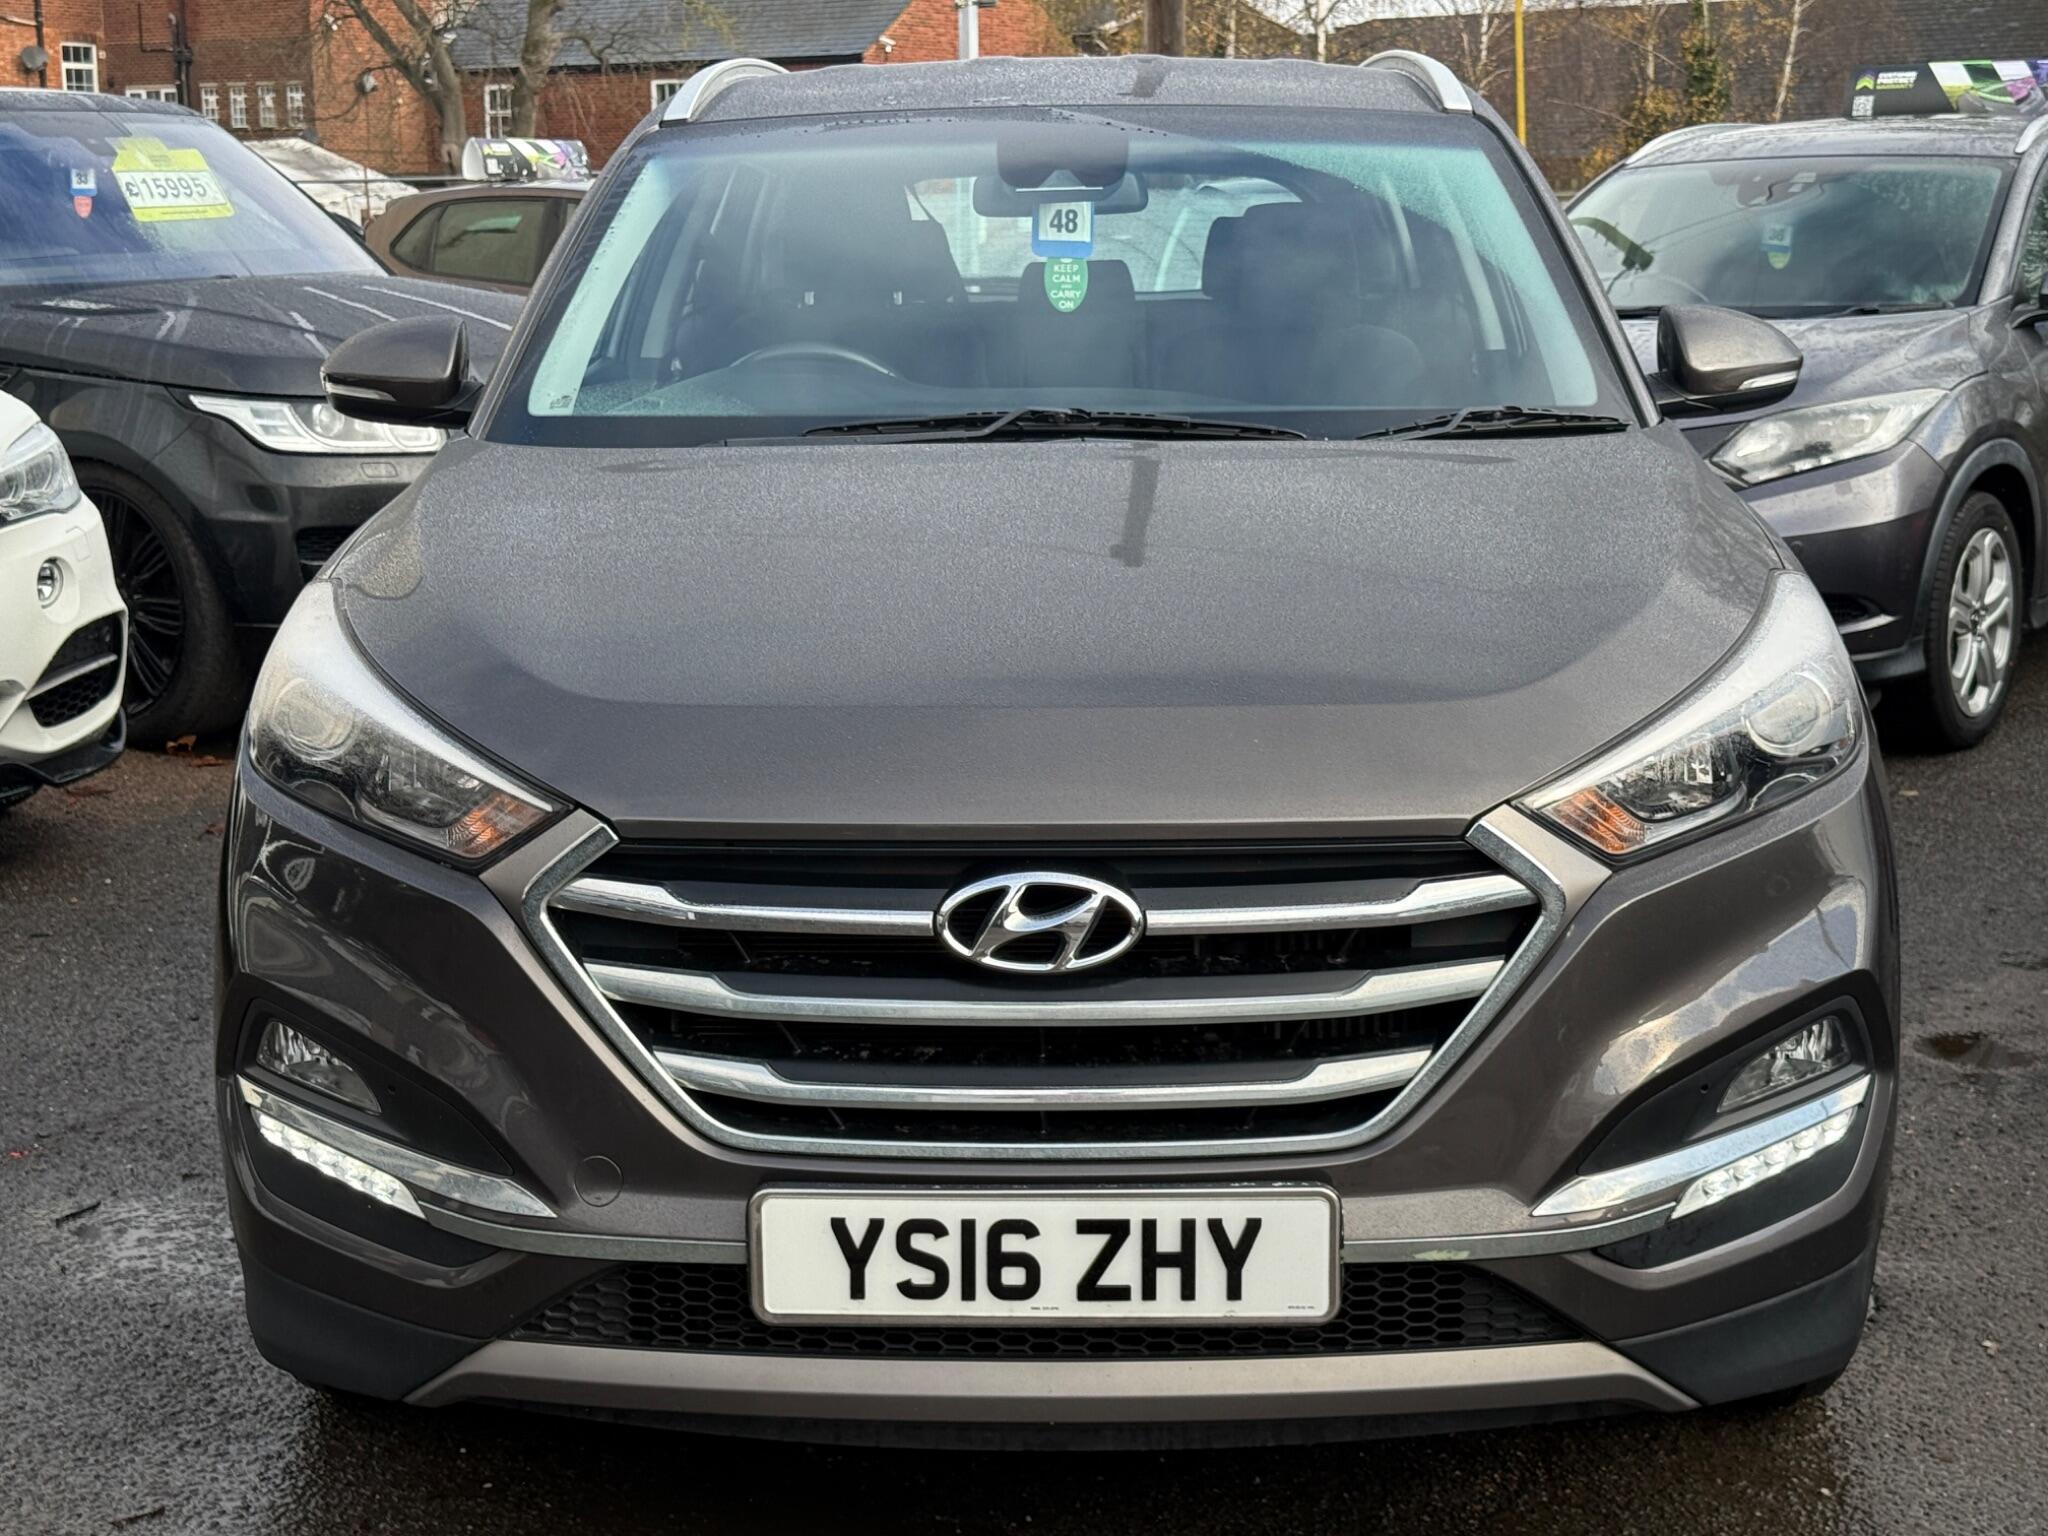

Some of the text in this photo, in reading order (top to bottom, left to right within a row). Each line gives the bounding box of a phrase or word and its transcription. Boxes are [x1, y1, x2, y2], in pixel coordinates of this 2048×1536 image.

[1048, 208, 1079, 234] 48
[1053, 264, 1080, 273] KEEP
[1052, 274, 1081, 283] CALM
[1049, 290, 1082, 299] CARRY
[1058, 300, 1075, 309] ON
[829, 1216, 1263, 1302] YS16 ZHY
